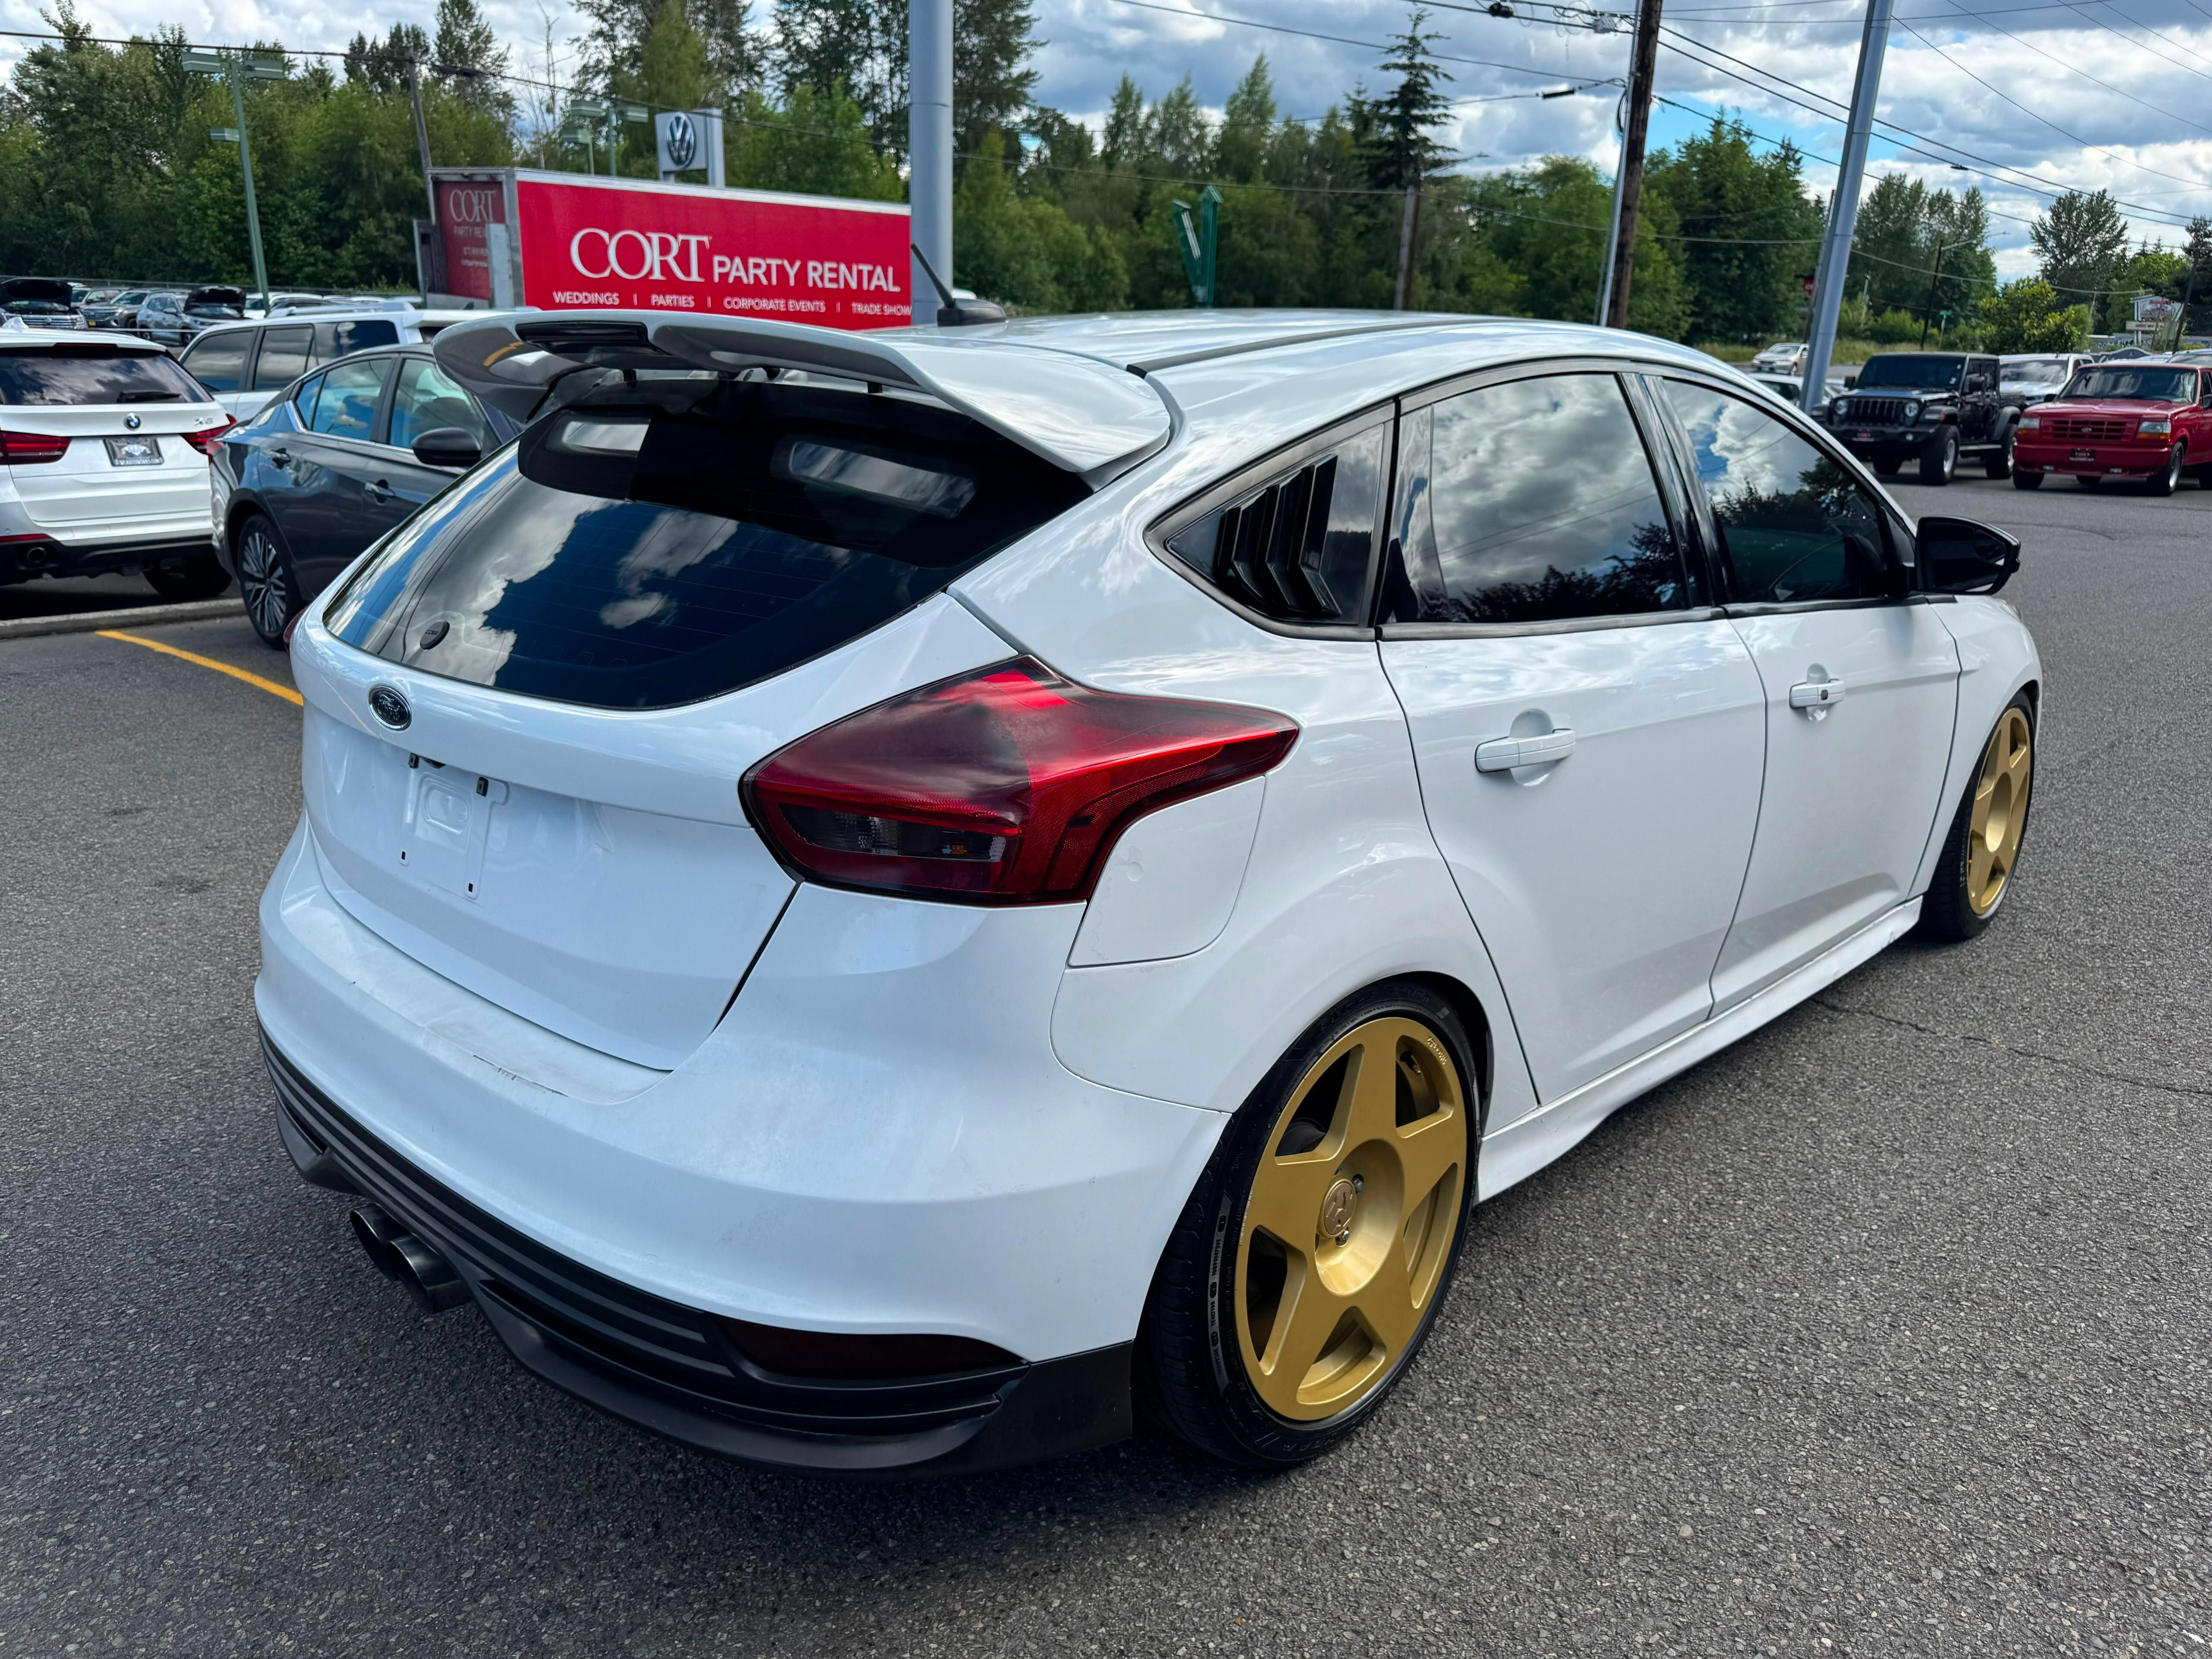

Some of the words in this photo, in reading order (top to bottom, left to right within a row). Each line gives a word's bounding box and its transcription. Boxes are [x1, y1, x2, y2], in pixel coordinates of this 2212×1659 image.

[450, 189, 496, 222] CORT
[570, 227, 710, 282] CORT
[713, 255, 801, 286] PARTY
[807, 260, 901, 292] RENTAL
[553, 291, 620, 305] WEDDINGS
[651, 294, 695, 308] PARTIES
[723, 296, 786, 311] CORPORATE
[788, 299, 826, 312] EVENTS
[851, 302, 882, 315] TRADE
